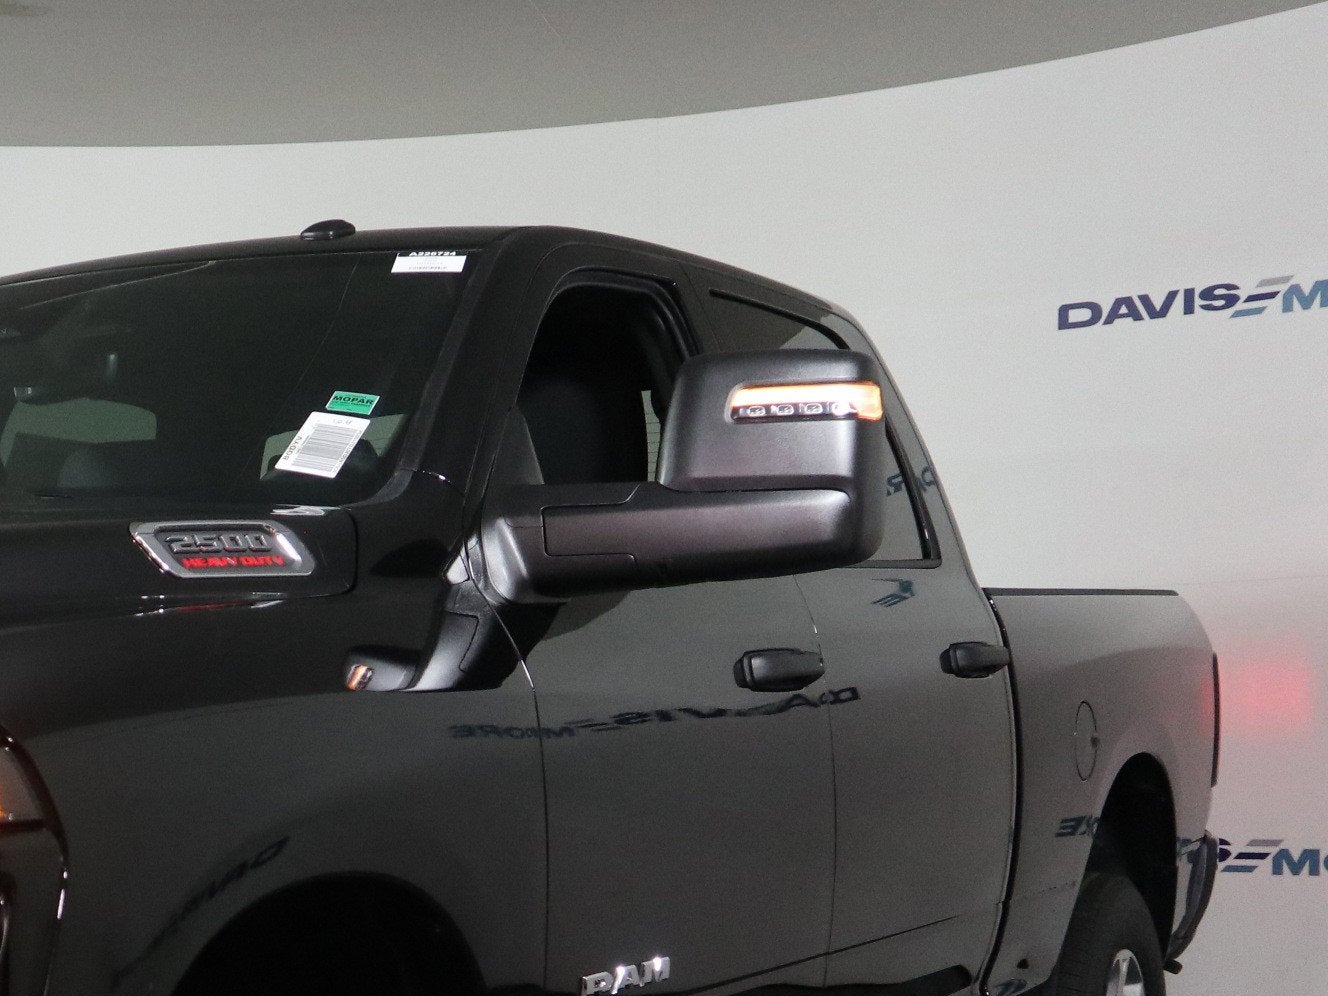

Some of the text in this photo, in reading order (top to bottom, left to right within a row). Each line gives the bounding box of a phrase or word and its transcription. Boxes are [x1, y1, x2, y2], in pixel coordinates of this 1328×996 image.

[1057, 283, 1241, 331] DAVIS
[332, 395, 374, 405] MOPAR
[165, 534, 272, 555] 2500
[181, 556, 284, 570] HEAVY DUTY
